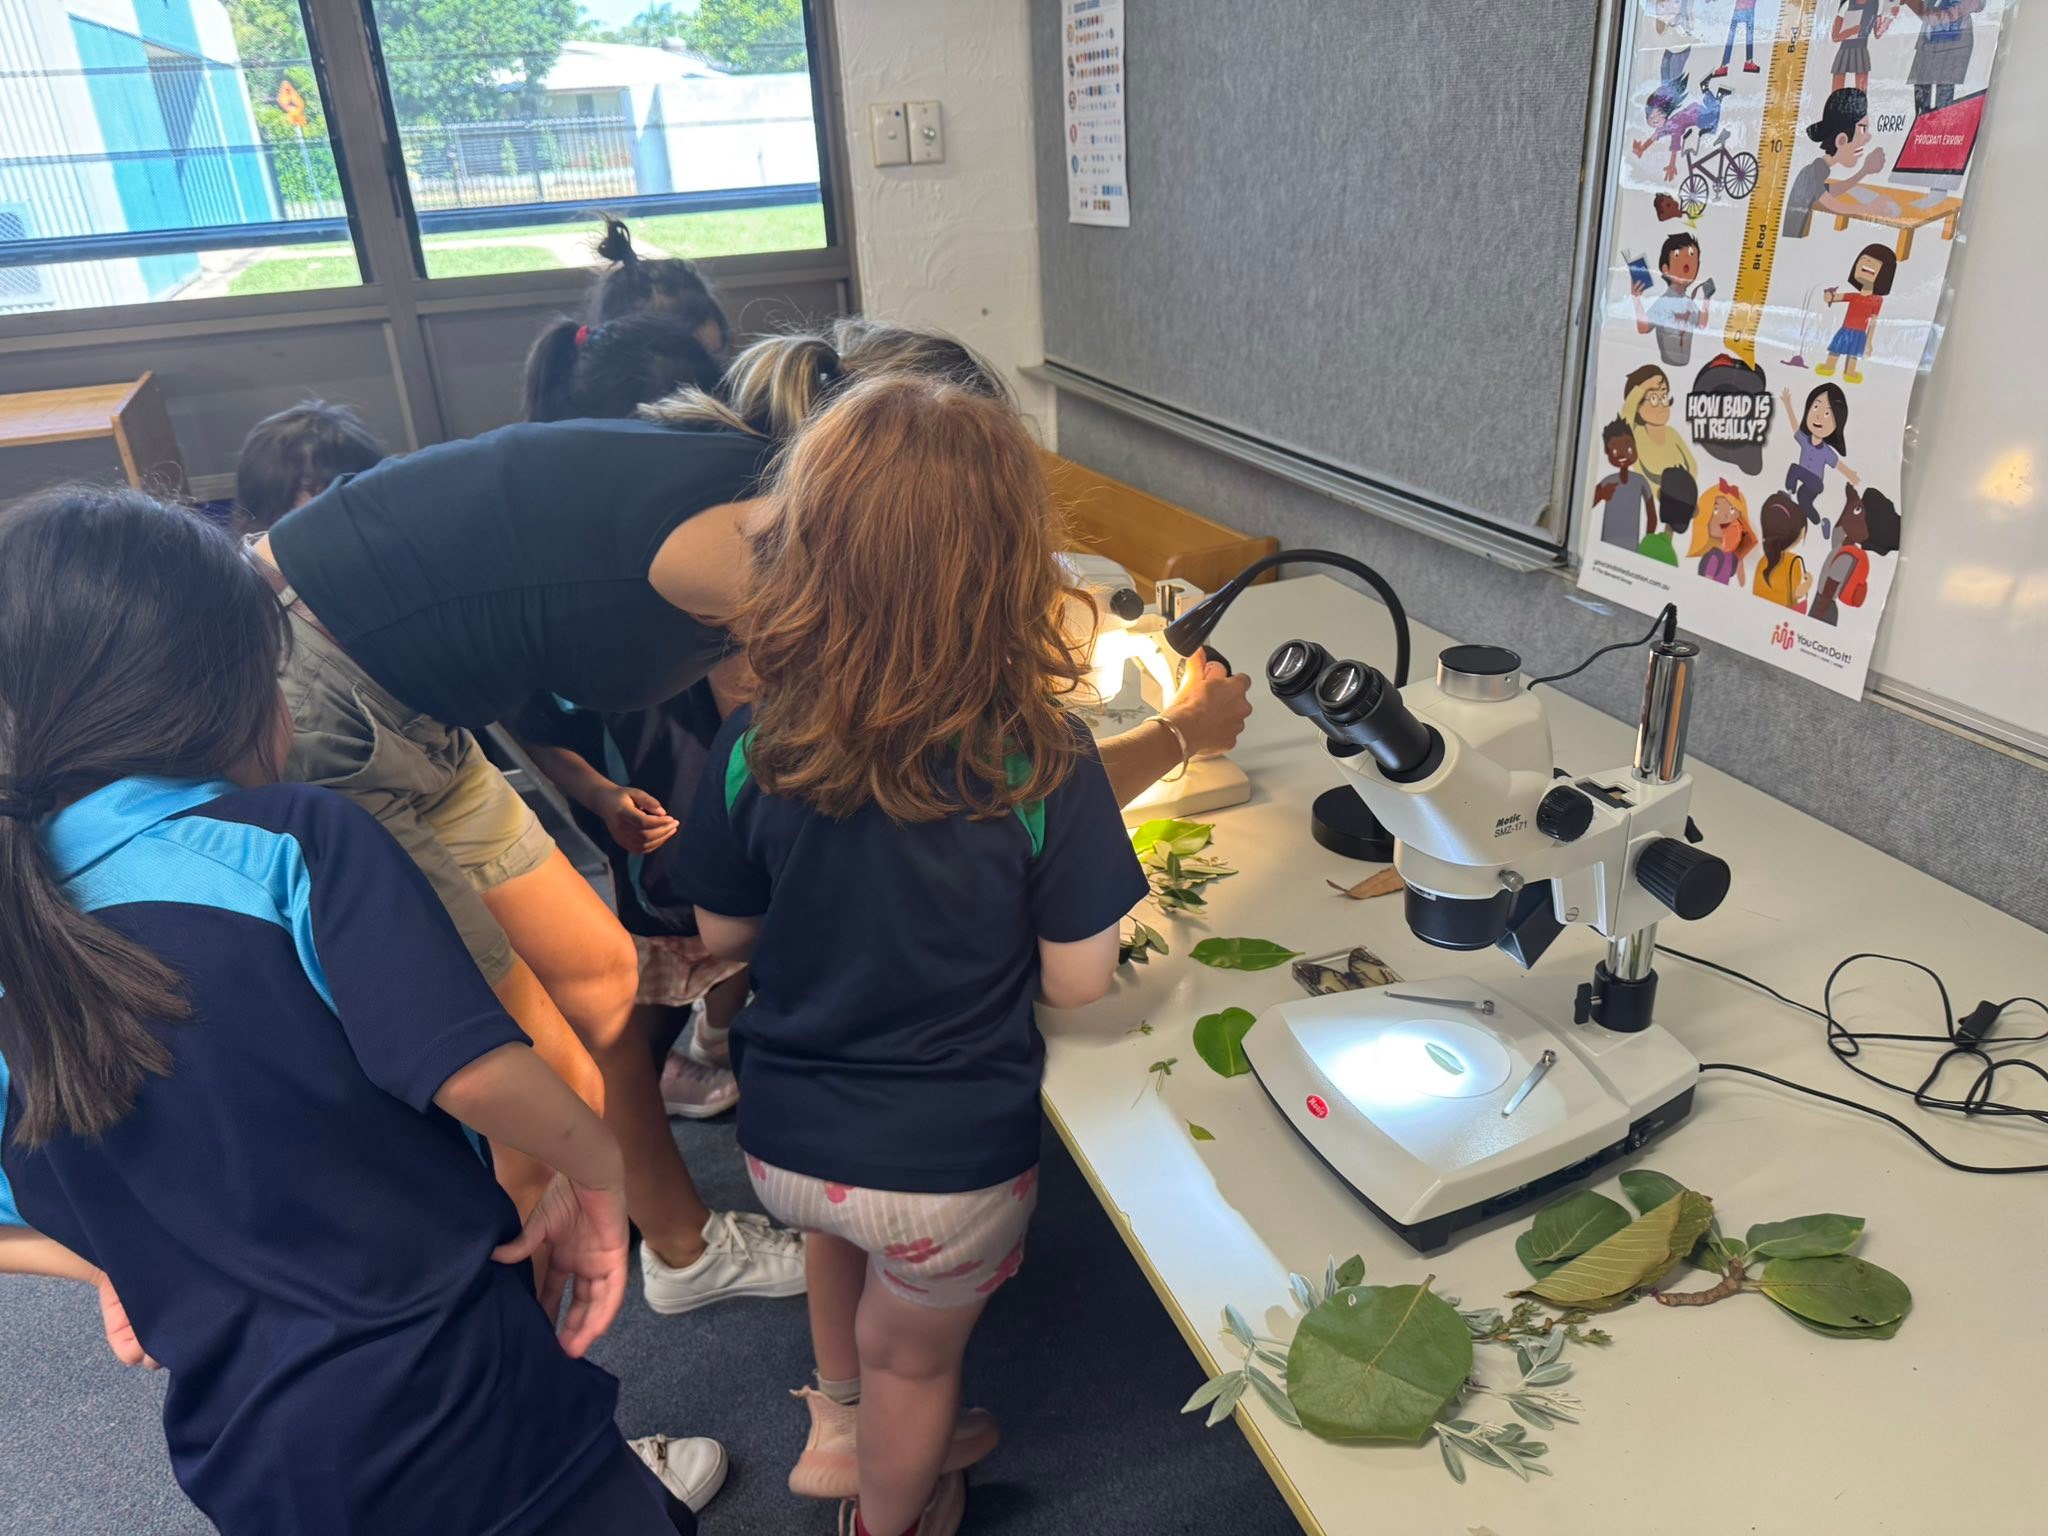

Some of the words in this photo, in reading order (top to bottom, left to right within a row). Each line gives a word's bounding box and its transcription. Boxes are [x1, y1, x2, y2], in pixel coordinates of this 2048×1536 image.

[1877, 114, 1906, 132] GRRR!
[1770, 139, 1783, 153] 10
[1914, 134, 1942, 145] PROGRAM
[1942, 134, 1965, 146] ERROR!
[1756, 224, 1767, 249] Bad
[1752, 253, 1762, 270] Bit
[1688, 394, 1721, 418] HOW
[1723, 394, 1752, 418] BAD
[1754, 394, 1771, 418] IS
[1694, 418, 1707, 439] IT
[1709, 418, 1767, 442] REALLY?
[1494, 820, 1527, 838] SMZ-171
[1495, 813, 1521, 828] Motic
